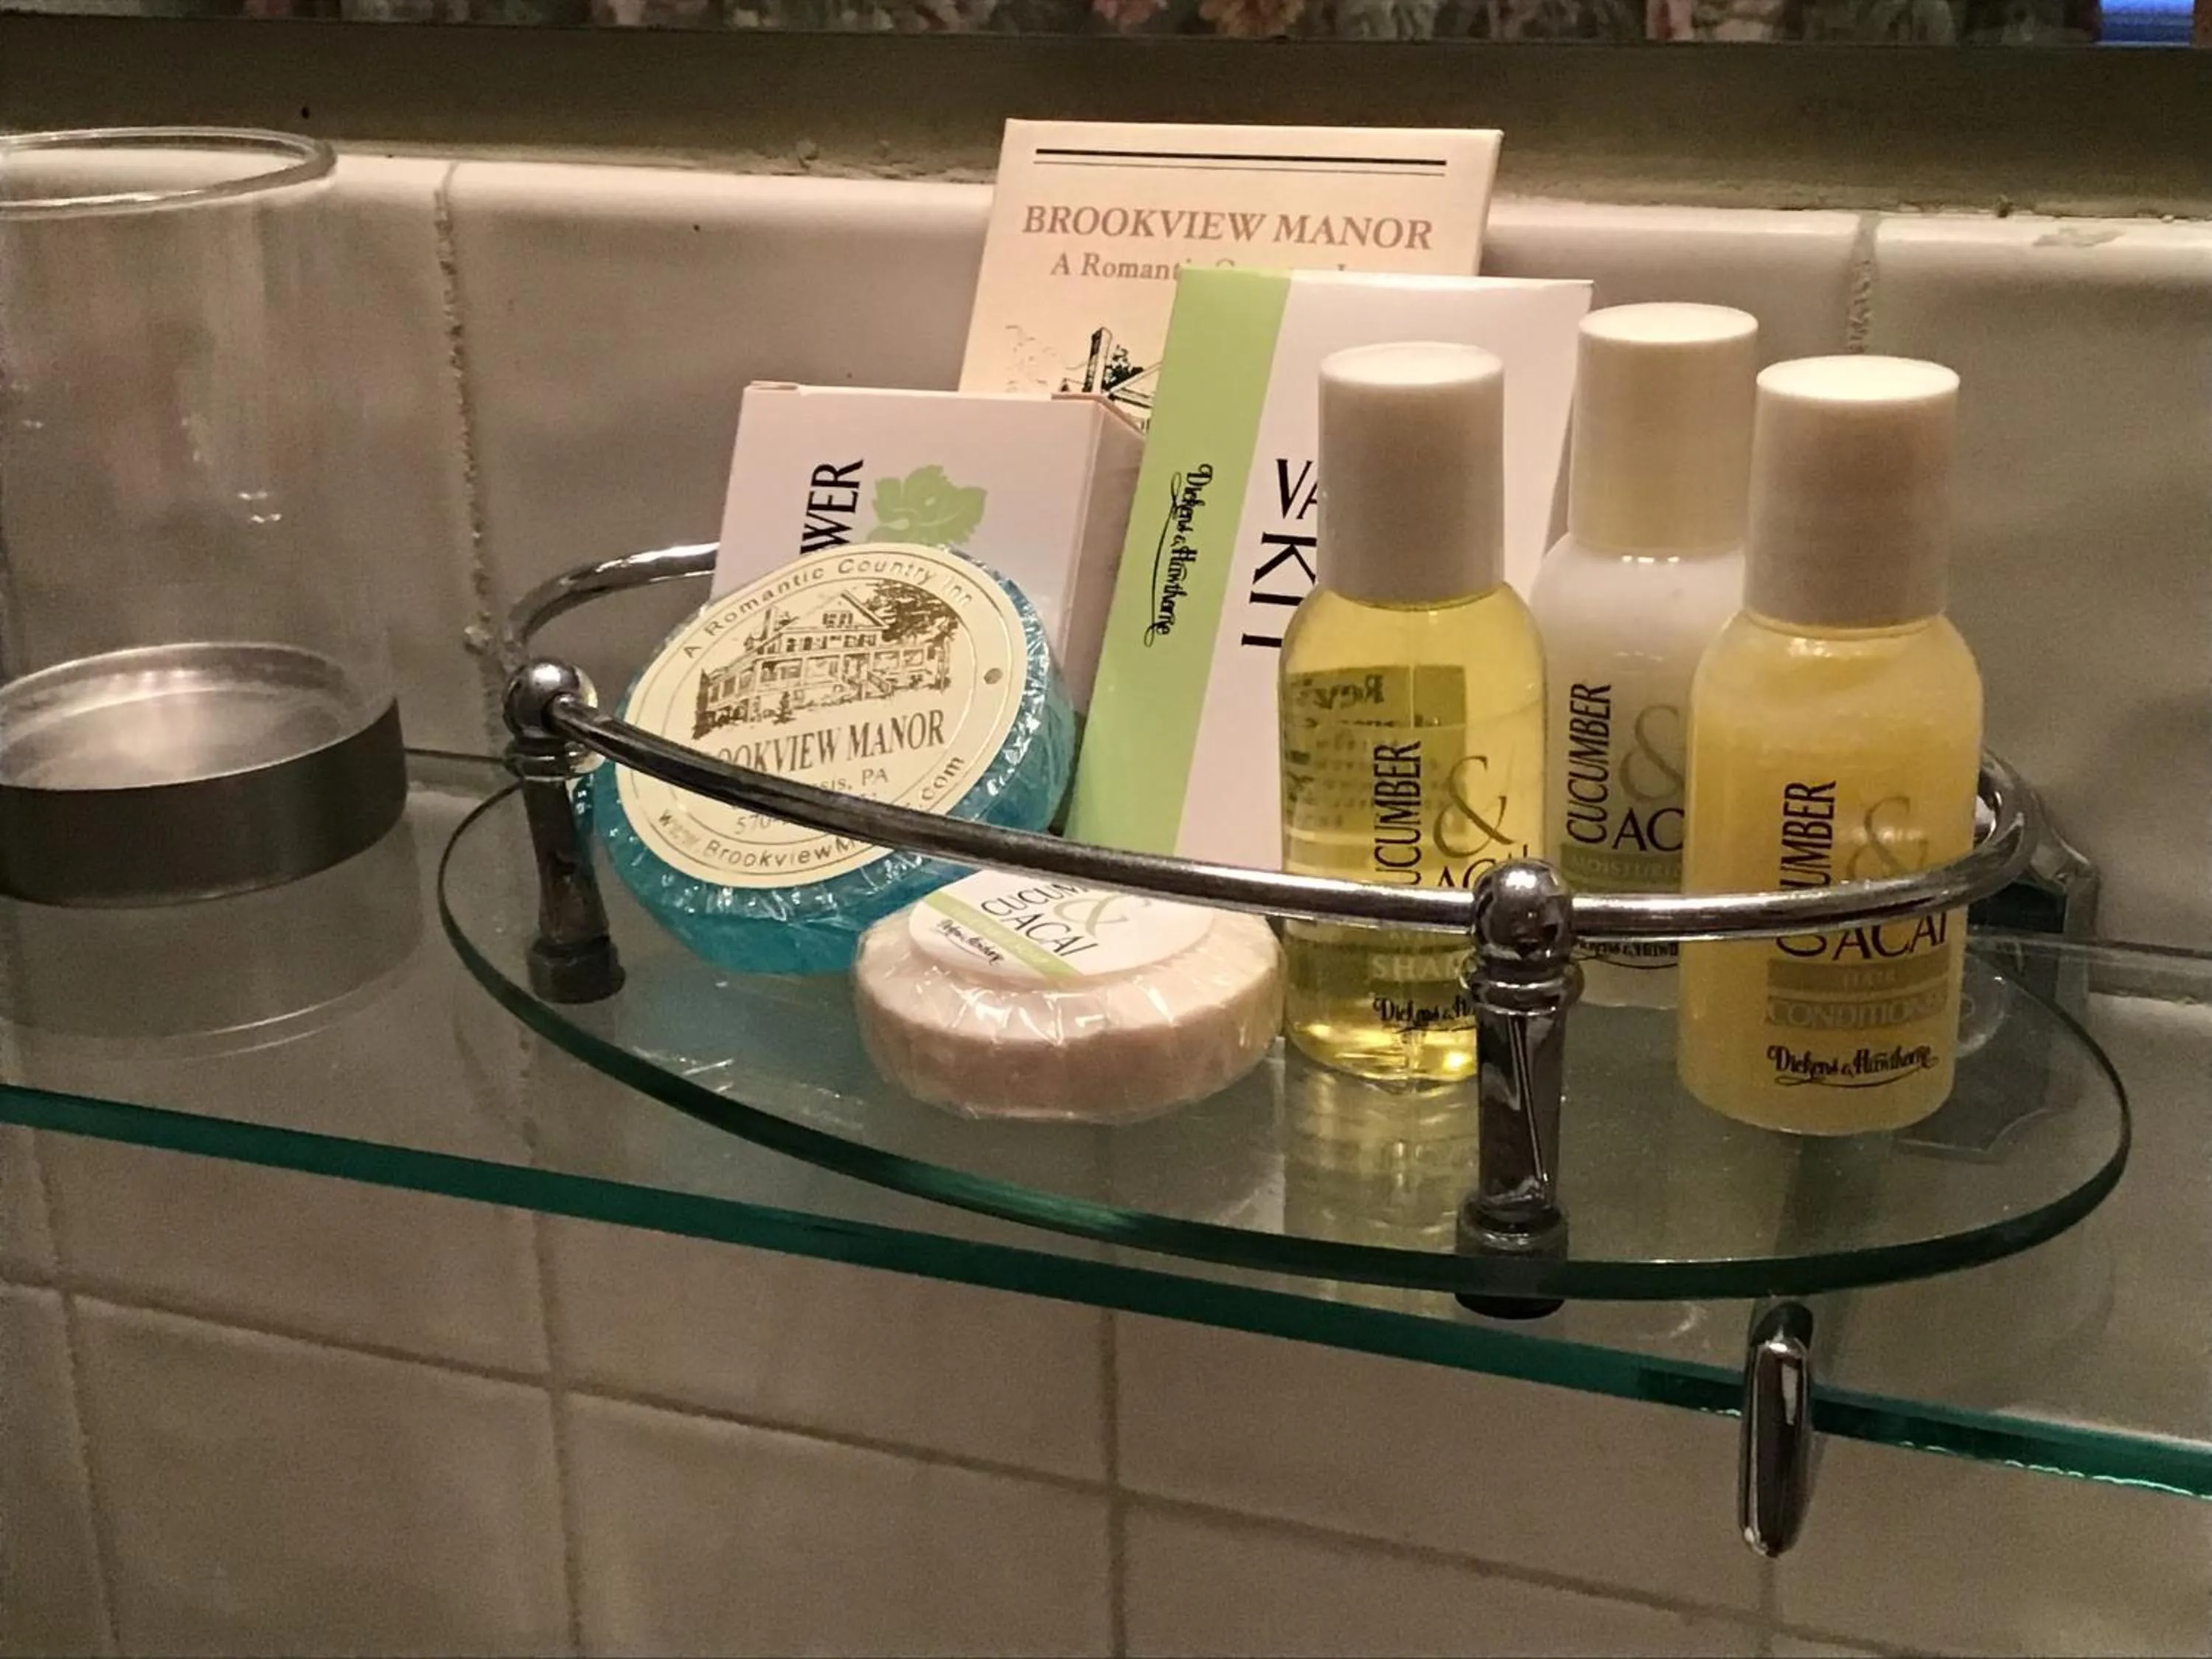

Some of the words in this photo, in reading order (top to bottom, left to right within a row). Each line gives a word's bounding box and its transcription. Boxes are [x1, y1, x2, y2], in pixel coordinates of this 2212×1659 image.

[1022, 205, 1267, 241] BROOKVIEW
[1273, 214, 1433, 251] MANOR
[1050, 252, 1071, 276] A
[1081, 253, 1189, 280] Romant
[799, 459, 864, 554] WER
[706, 565, 825, 637] Romantic
[838, 557, 937, 583] Country
[846, 709, 946, 762] MANOR
[860, 768, 889, 787] PA
[1565, 682, 1613, 846] CUCUMBER
[1372, 740, 1422, 885] UCUMBER
[1611, 807, 1686, 852] AC
[980, 884, 1090, 917] CUCUM
[998, 913, 1099, 958] ACAI
